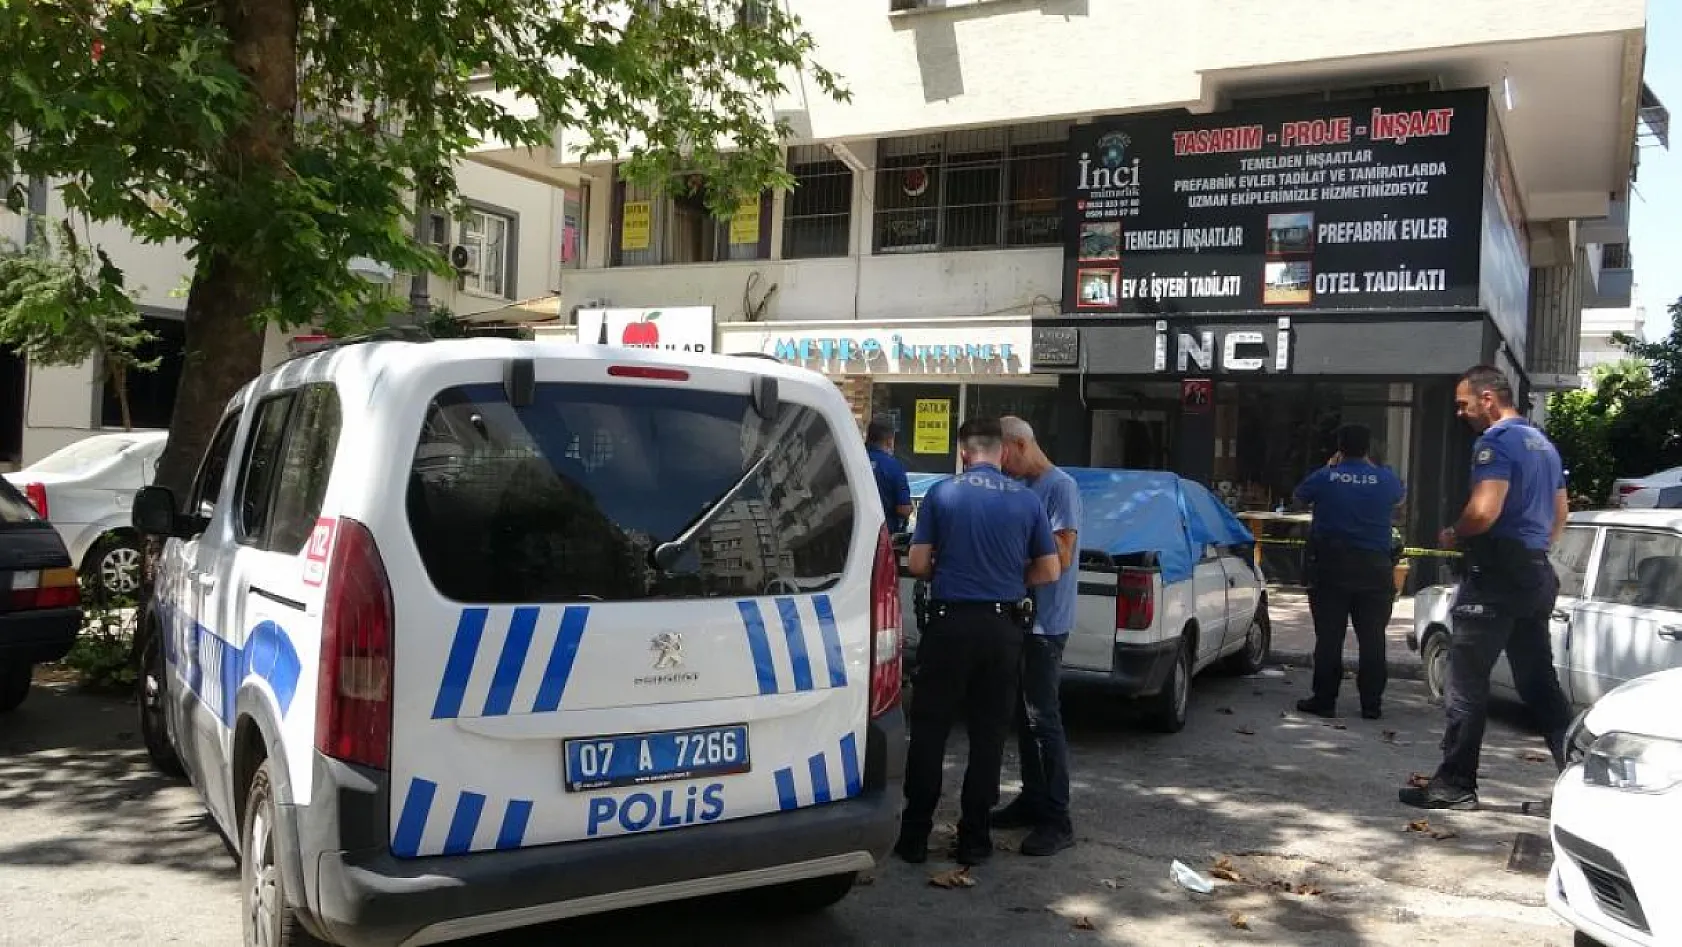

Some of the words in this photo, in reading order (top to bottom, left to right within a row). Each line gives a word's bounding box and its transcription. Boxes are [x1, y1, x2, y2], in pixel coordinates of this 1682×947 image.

[1173, 124, 1263, 156] TASARIM
[1281, 116, 1352, 147] PROJE
[1370, 107, 1454, 145] İNŞAAT
[1077, 152, 1141, 189] İnci
[1240, 154, 1302, 171] TEMELDEN
[1306, 148, 1372, 168] İNŞAATLAR
[1174, 173, 1237, 192] PREFABRİK
[1239, 174, 1276, 188] EVLER
[1278, 168, 1327, 185] TADİLAT
[1330, 168, 1346, 182] VE
[1349, 161, 1447, 181] TAMİRATLARDA
[1188, 193, 1229, 208] UZMAN
[1231, 187, 1319, 206] EKİPLERİMİZLE
[1321, 178, 1429, 200] HİZMETİNİZDEYİZ
[1124, 229, 1181, 251] TEMELDEN
[1183, 222, 1243, 253] İNŞAATLAR
[1318, 213, 1398, 243] PREFABRİK
[1401, 217, 1447, 240] EVLER
[1122, 279, 1137, 298] EV
[1139, 278, 1149, 298] &
[1151, 271, 1187, 302] İŞYERİ
[1190, 269, 1242, 298] TADİLATI
[1315, 272, 1360, 294] OTEL
[1363, 264, 1446, 292] TADİLATI
[774, 336, 882, 361] METRO
[579, 742, 615, 777] 07
[638, 739, 654, 771] A
[674, 731, 737, 767] 7266
